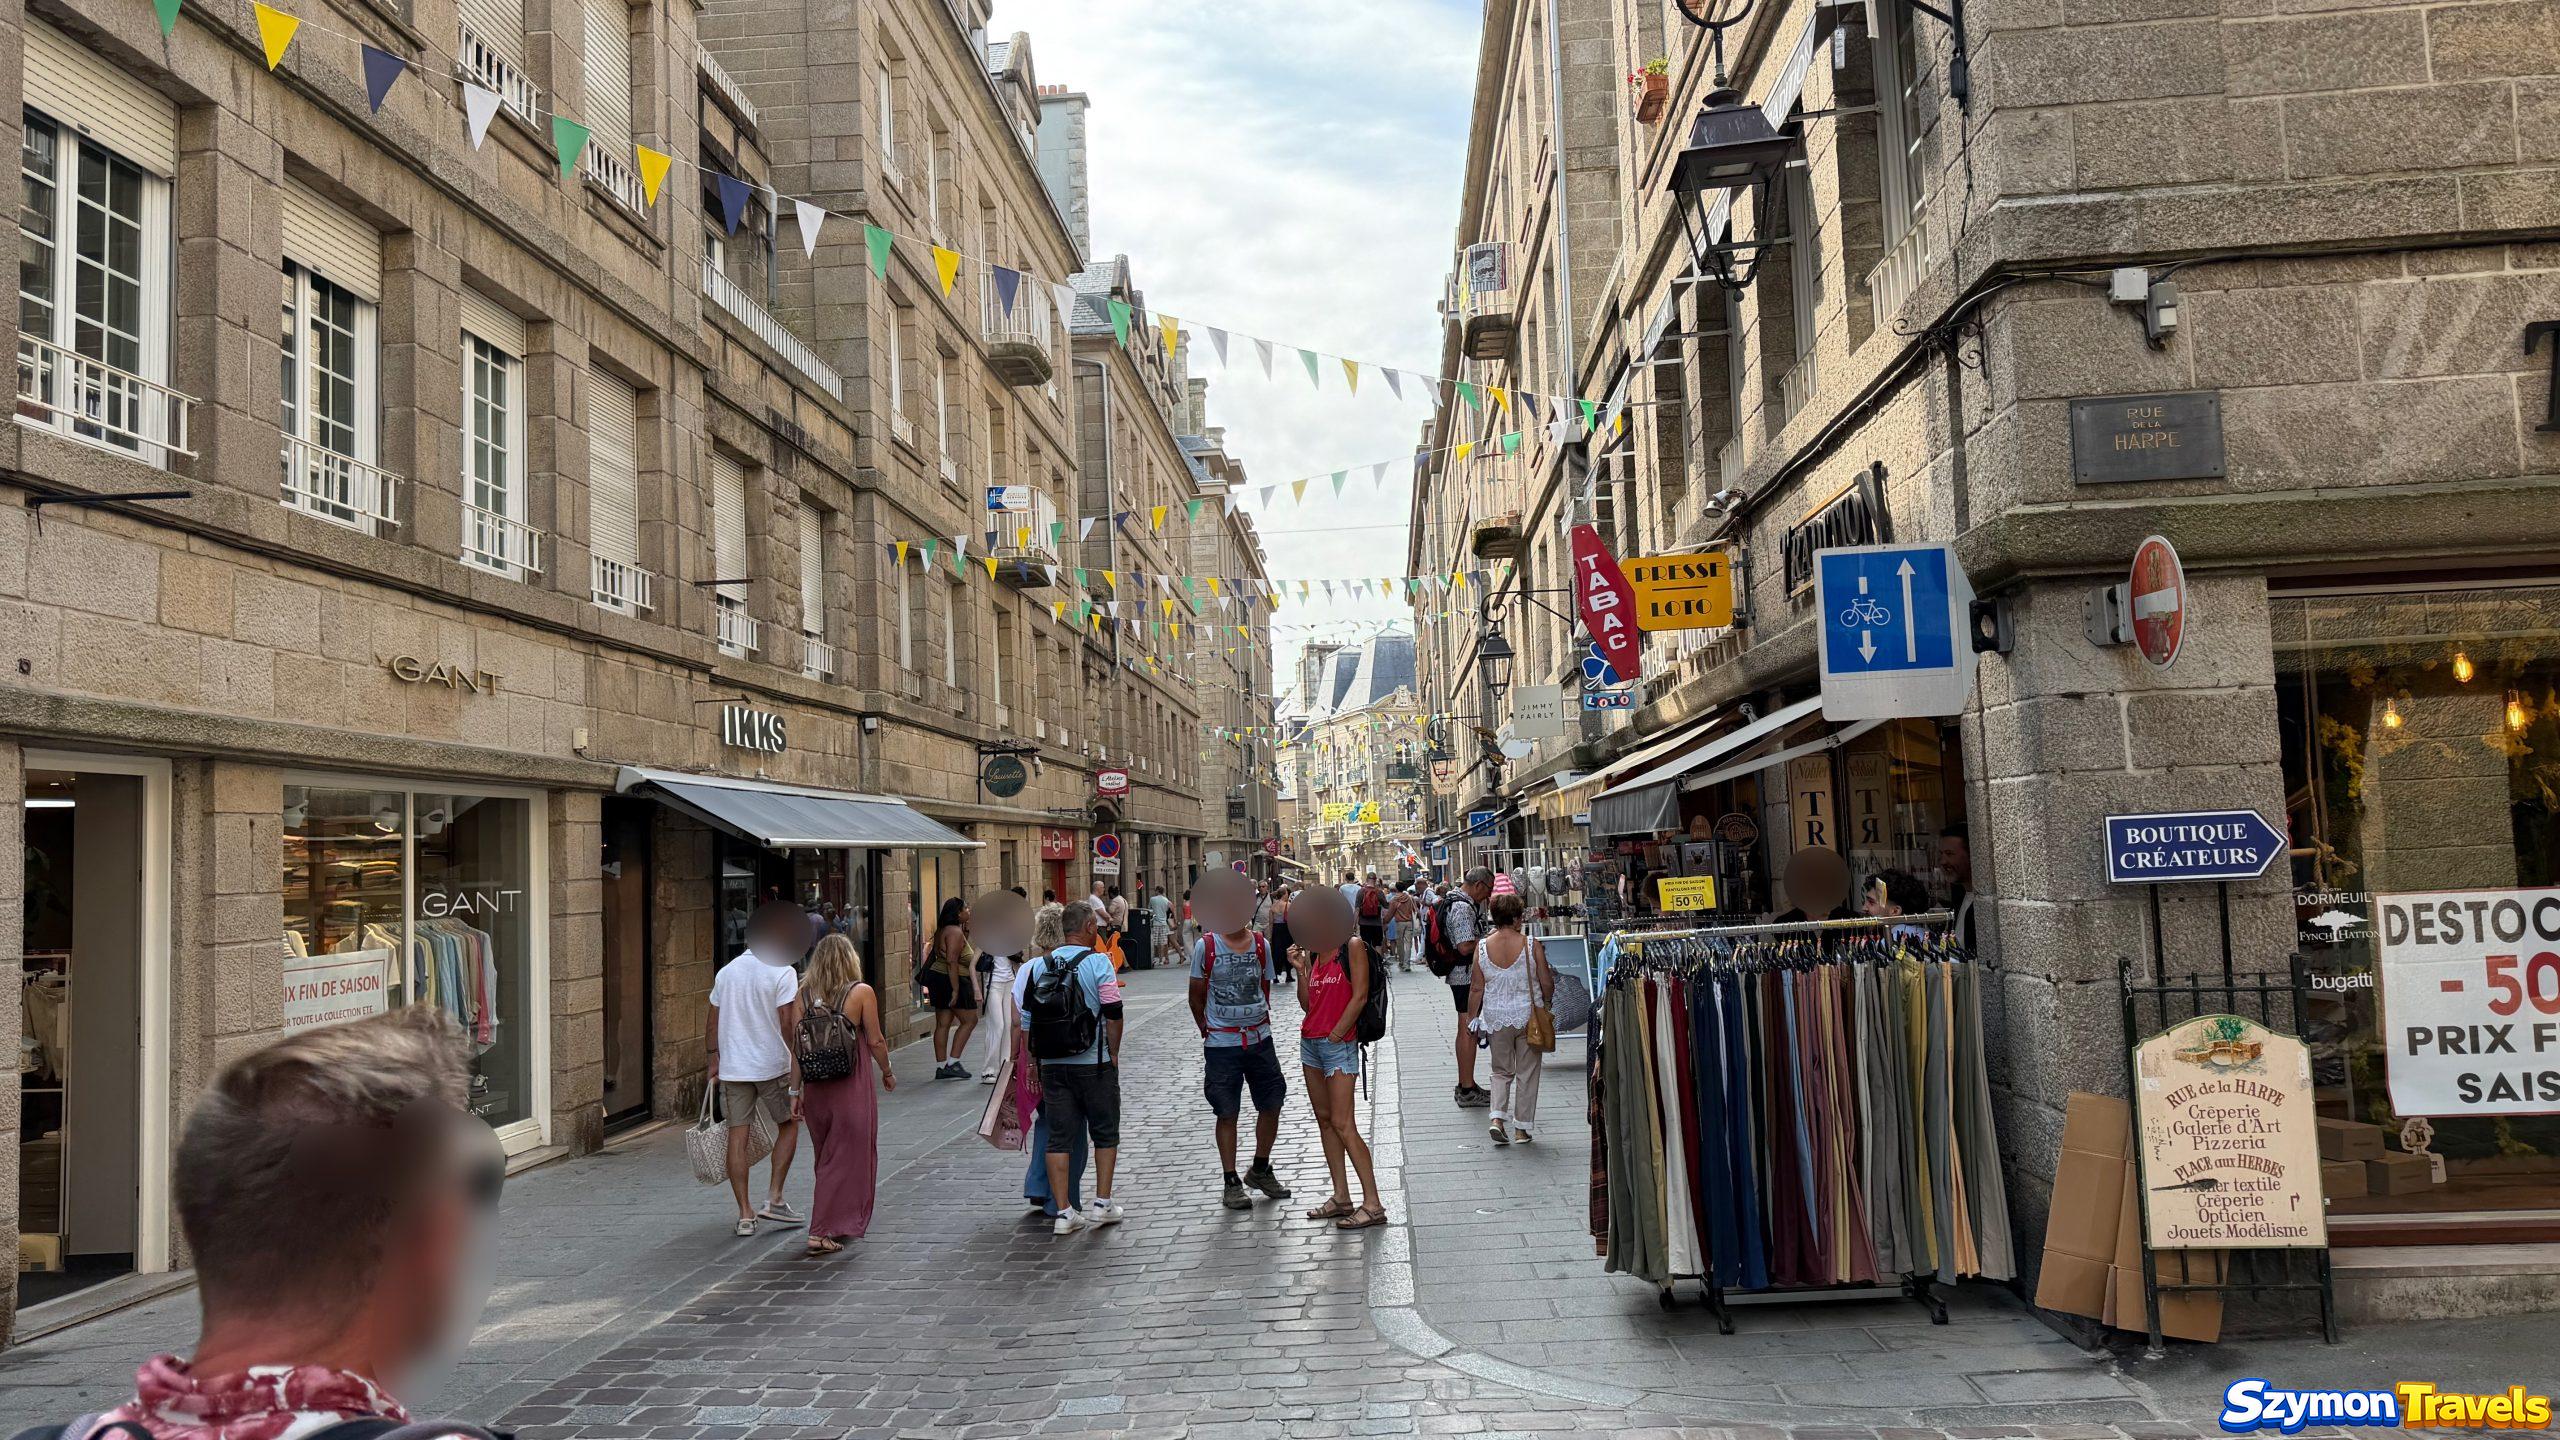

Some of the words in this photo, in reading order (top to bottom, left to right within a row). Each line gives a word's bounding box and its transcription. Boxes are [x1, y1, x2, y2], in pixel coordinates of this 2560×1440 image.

[2127, 406, 2165, 419] RUE
[2132, 421, 2146, 429] DE
[2114, 431, 2182, 451] HARPE
[1635, 561, 1725, 583] PRESSE
[1581, 554, 1627, 650] TABAC
[1651, 598, 1712, 618] LOTO
[390, 655, 504, 695] GANT
[1521, 702, 1554, 711] JIMMY
[1585, 695, 1630, 708] LOTO
[1521, 712, 1554, 720] FAIRLY
[723, 704, 787, 753] IKKS
[2125, 823, 2248, 845] BOUTIQUE
[2119, 846, 2258, 869] CRÉATEURS
[422, 890, 522, 918] GANT
[1675, 896, 1690, 907] 50
[2297, 892, 2373, 906] DORMEUIL
[2299, 931, 2333, 941] FYNCH
[299, 982, 318, 1000] FIN
[321, 980, 337, 997] DE
[339, 975, 380, 996] SAISON
[2311, 971, 2373, 993] bugatti
[2485, 951, 2560, 1016] 50
[292, 1015, 313, 1027] TOUTE
[314, 1014, 324, 1025] LA
[324, 1007, 362, 1022] COLLECTION
[2406, 1024, 2518, 1057] PRIX
[2532, 1022, 2560, 1053] F
[2165, 1084, 2197, 1110] RUE
[2199, 1082, 2215, 1095] de
[2217, 1080, 2231, 1093] la
[2233, 1078, 2286, 1108] HARPE
[468, 1104, 493, 1116] ANT
[2188, 1104, 2261, 1123] Crêperie
[2173, 1120, 2232, 1136] Galerie
[2237, 1118, 2282, 1135] d'Art
[2193, 1135, 2266, 1151] Pizzeria
[2173, 1155, 2213, 1182] PLACE
[2214, 1158, 2237, 1169] aux
[2237, 1153, 2286, 1179] HERBES
[2234, 1177, 2281, 1192] textile
[2196, 1193, 2265, 1213] Crêperie
[2198, 1208, 2266, 1227] Opticien
